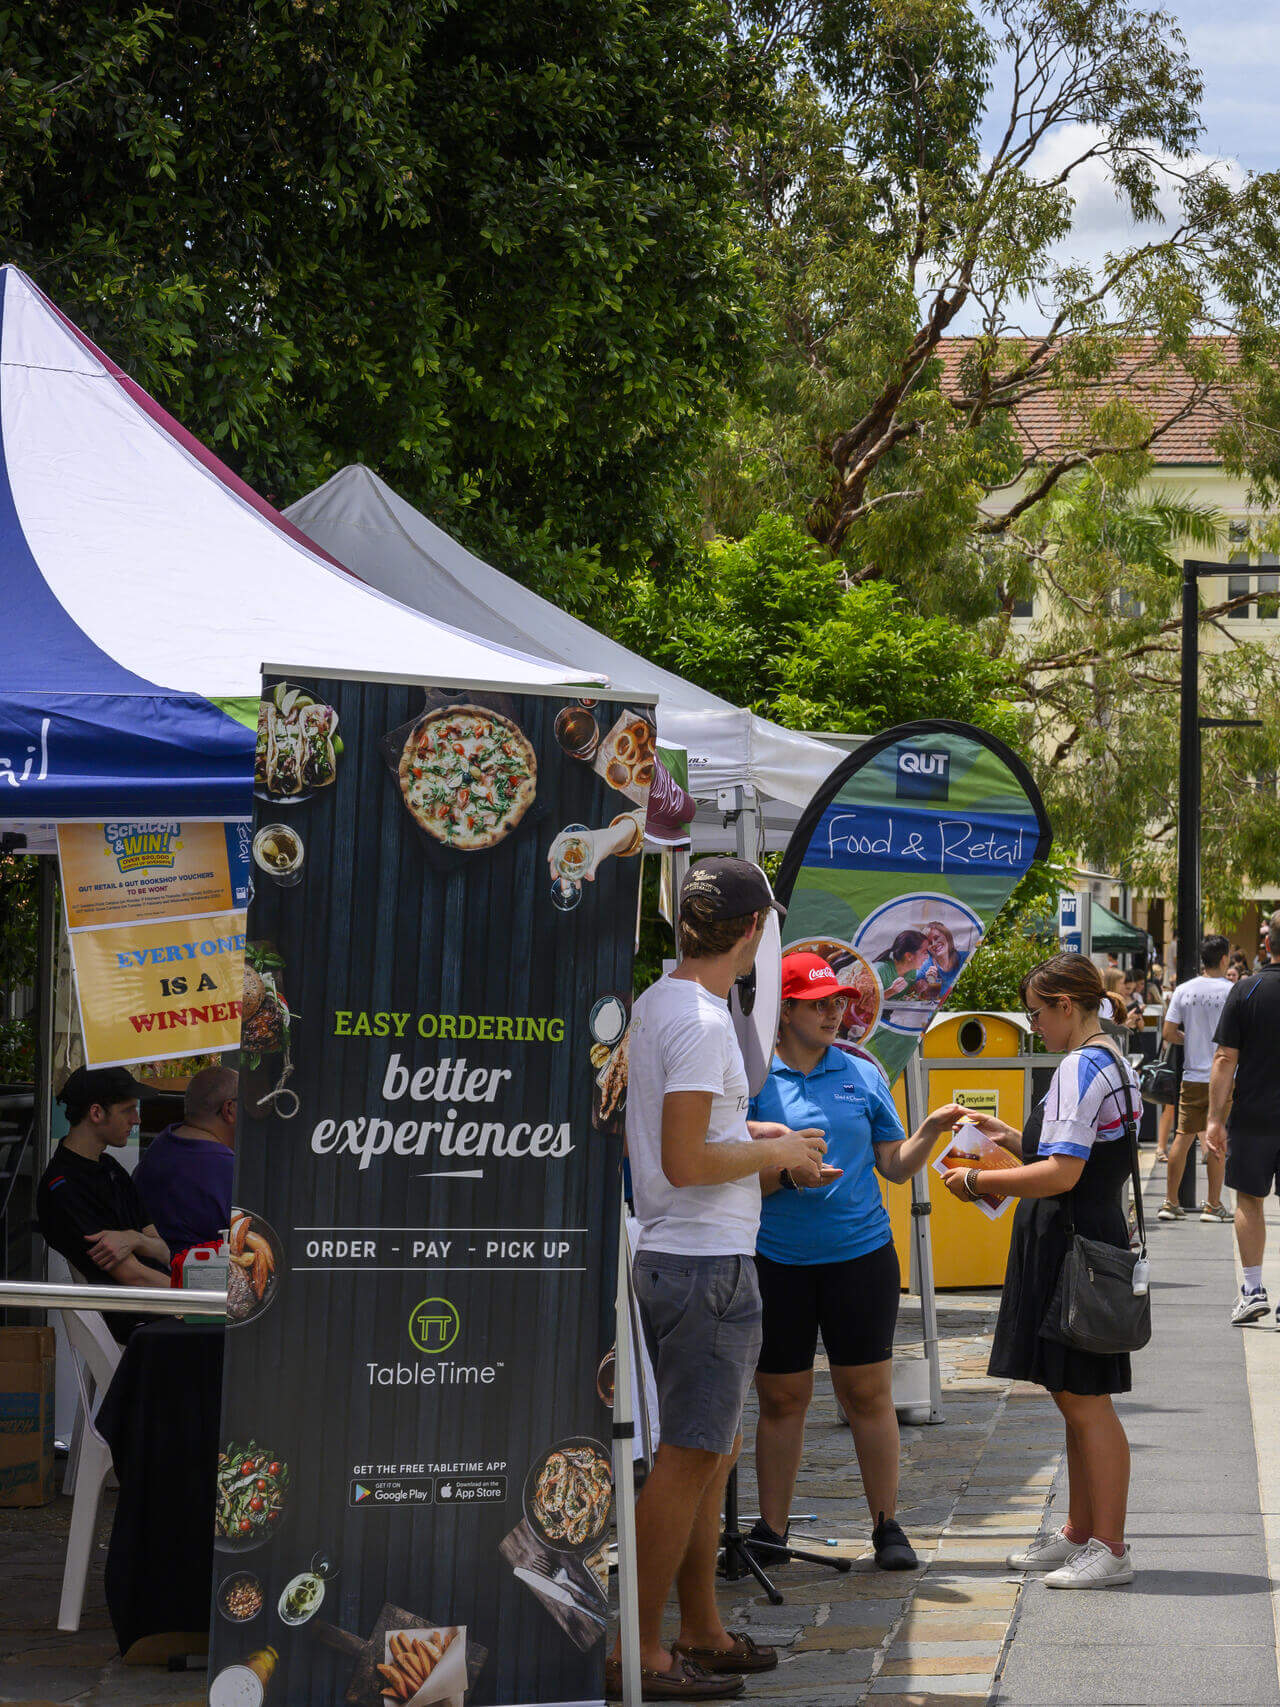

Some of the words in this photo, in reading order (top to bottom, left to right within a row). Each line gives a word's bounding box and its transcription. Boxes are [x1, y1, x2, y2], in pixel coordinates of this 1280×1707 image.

[899, 752, 949, 775] QUT
[123, 832, 169, 855] WIN!
[828, 814, 893, 860] Food
[900, 832, 927, 861] &
[938, 820, 1023, 873] Retail
[94, 883, 118, 891] RETAIL
[140, 876, 177, 886] BOOKSHOP
[116, 933, 247, 969] EVERYONE
[160, 976, 189, 997] IS
[197, 972, 218, 992] A
[128, 1000, 243, 1034] WINNER
[334, 1010, 411, 1037] EASY
[417, 1013, 565, 1042] ORDERING
[382, 1053, 512, 1103] better
[311, 1108, 576, 1170] experiences
[306, 1240, 377, 1258] ORDER
[412, 1241, 452, 1258] PAY
[486, 1241, 535, 1258] PICK
[543, 1241, 571, 1259] UP
[353, 1465, 374, 1475] GET
[376, 1464, 397, 1474] THE
[399, 1463, 425, 1474] FREE
[427, 1462, 484, 1473] TABLETIME
[486, 1461, 507, 1472] APP
[374, 1489, 408, 1502] Google
[409, 1488, 428, 1501] Play
[455, 1488, 475, 1500] App
[476, 1487, 502, 1497] Store
